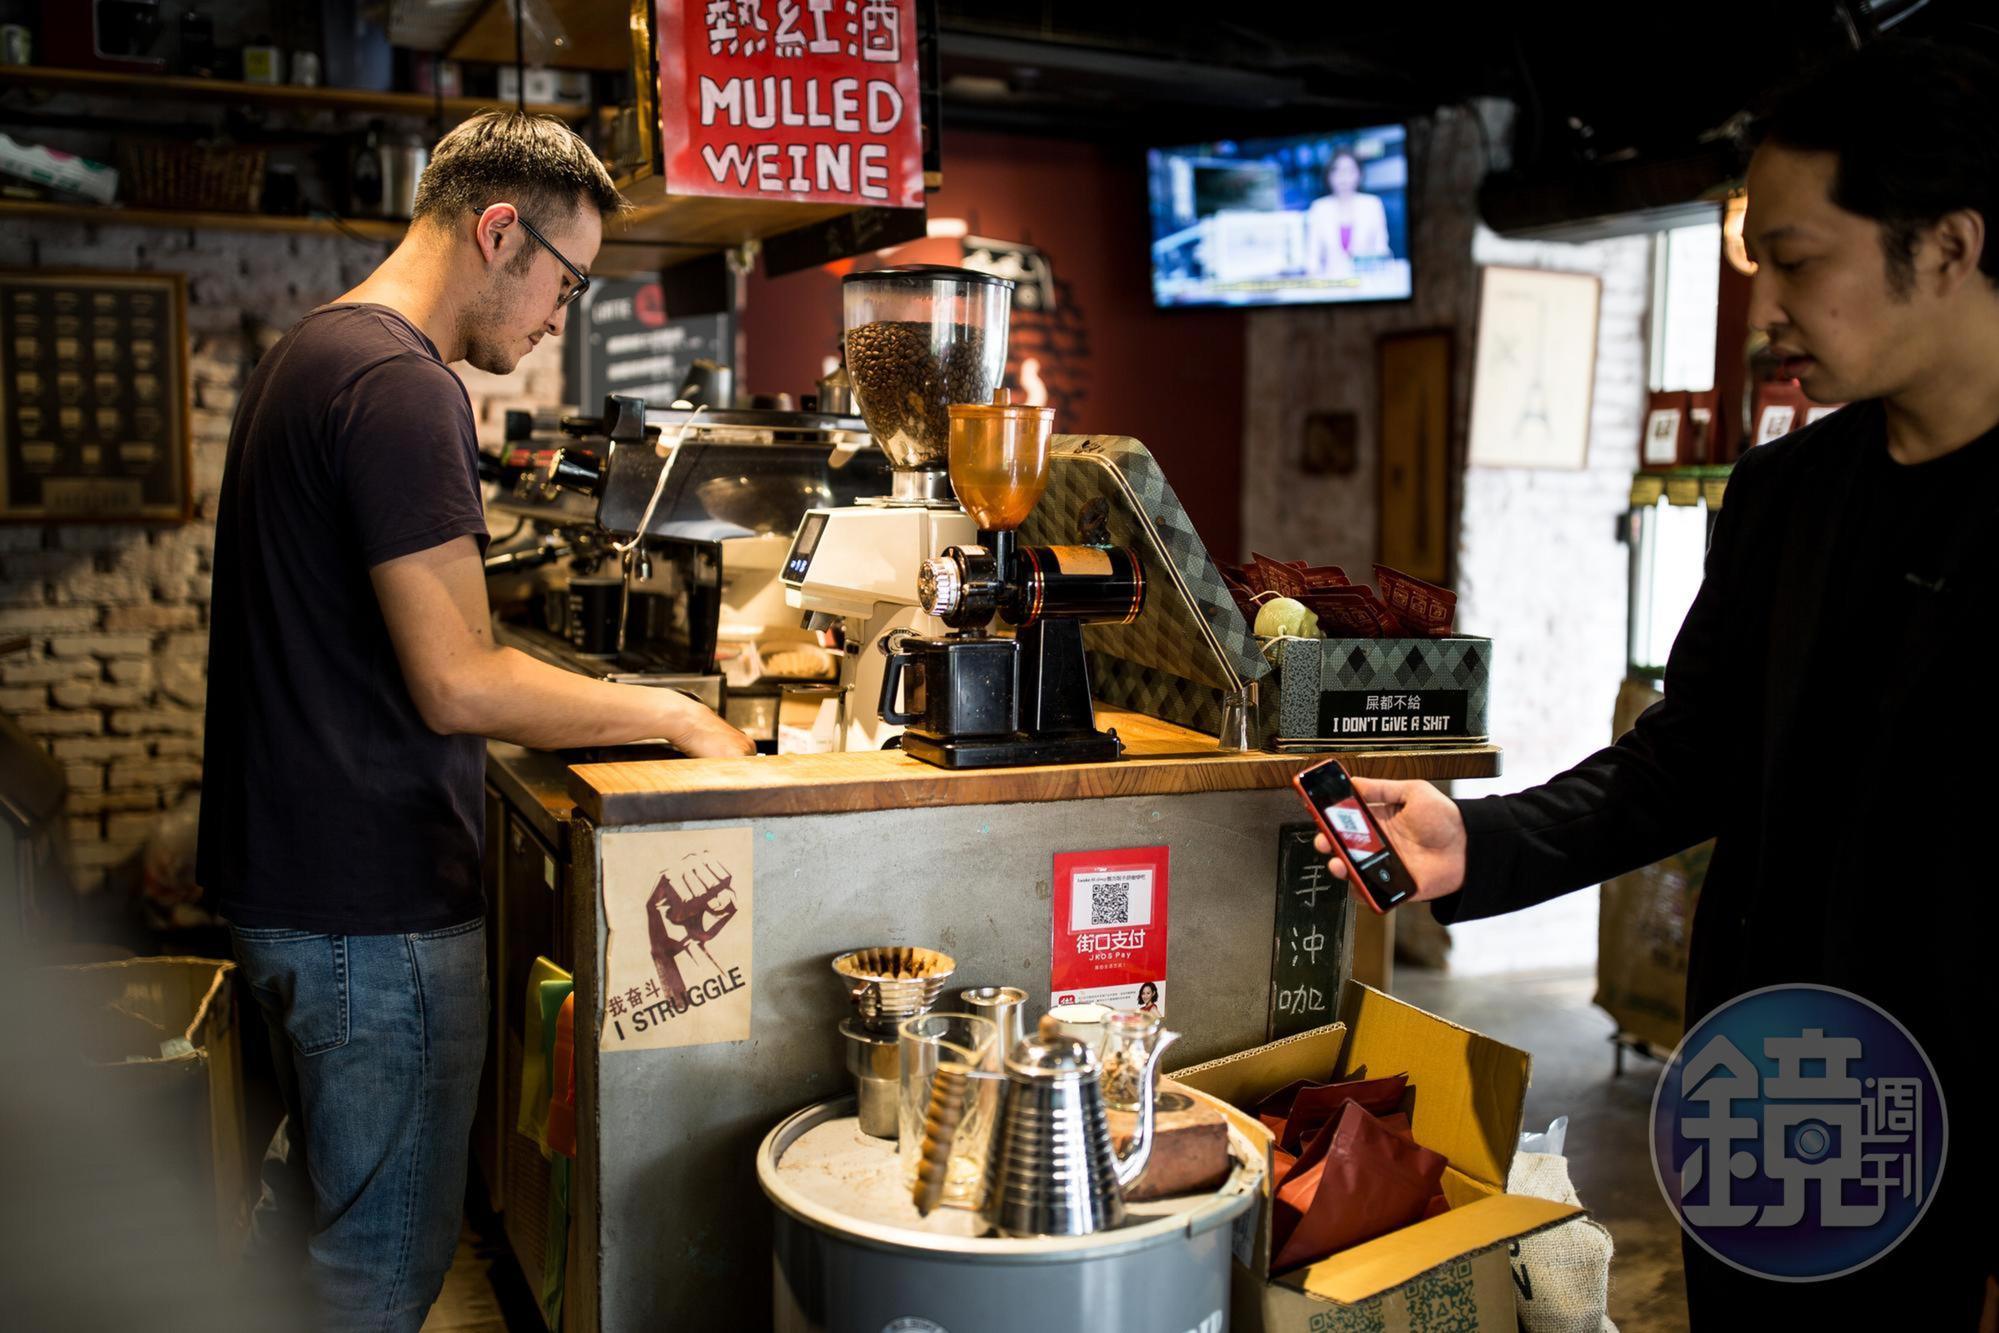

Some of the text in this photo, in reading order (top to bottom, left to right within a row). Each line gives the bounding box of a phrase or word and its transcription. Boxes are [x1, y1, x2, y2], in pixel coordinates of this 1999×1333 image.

[700, 76, 903, 134] MULLED
[701, 143, 888, 199] WEINE
[1366, 694, 1421, 711] 屎都不給
[1333, 717, 1338, 733] I
[1342, 716, 1378, 732] DON'T
[1411, 716, 1419, 731] A
[1076, 928, 1146, 954] 街口支付
[1088, 951, 1132, 961] JKOS Pay
[608, 978, 661, 1018] 我奋斗
[613, 966, 746, 1041] I STRUGGLE
